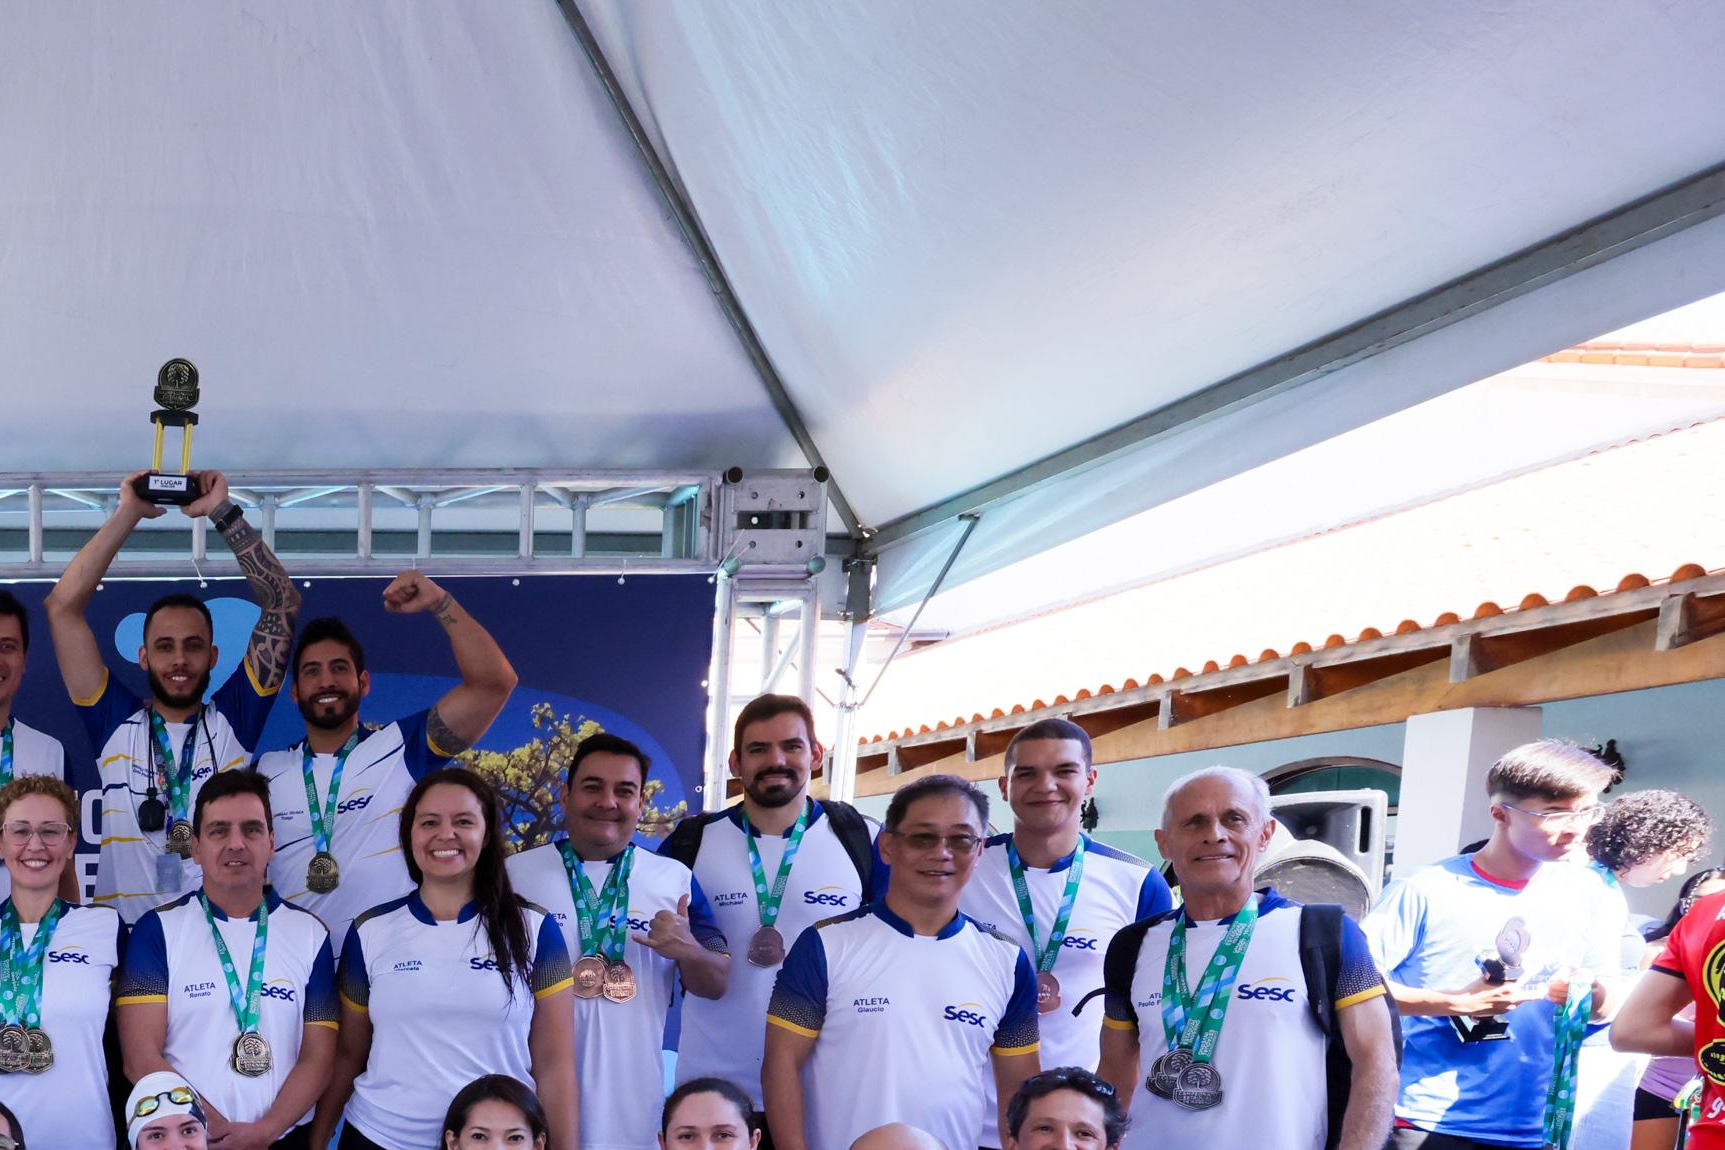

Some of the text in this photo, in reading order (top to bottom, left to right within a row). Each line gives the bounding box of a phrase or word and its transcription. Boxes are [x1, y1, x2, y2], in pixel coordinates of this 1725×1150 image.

[714, 892, 747, 902] ATLETA
[804, 891, 847, 906] Sesc
[609, 916, 649, 932] Ssc
[1059, 936, 1097, 950] esc
[49, 951, 89, 964] Sesc
[393, 960, 423, 970] ATLETA
[184, 982, 215, 992] ATLETA
[261, 982, 295, 1002] Sesc
[1238, 984, 1295, 1002] Sesc
[853, 998, 890, 1006] ATLETA
[1139, 1000, 1155, 1008] Paulo
[943, 1006, 986, 1028] Sesc
